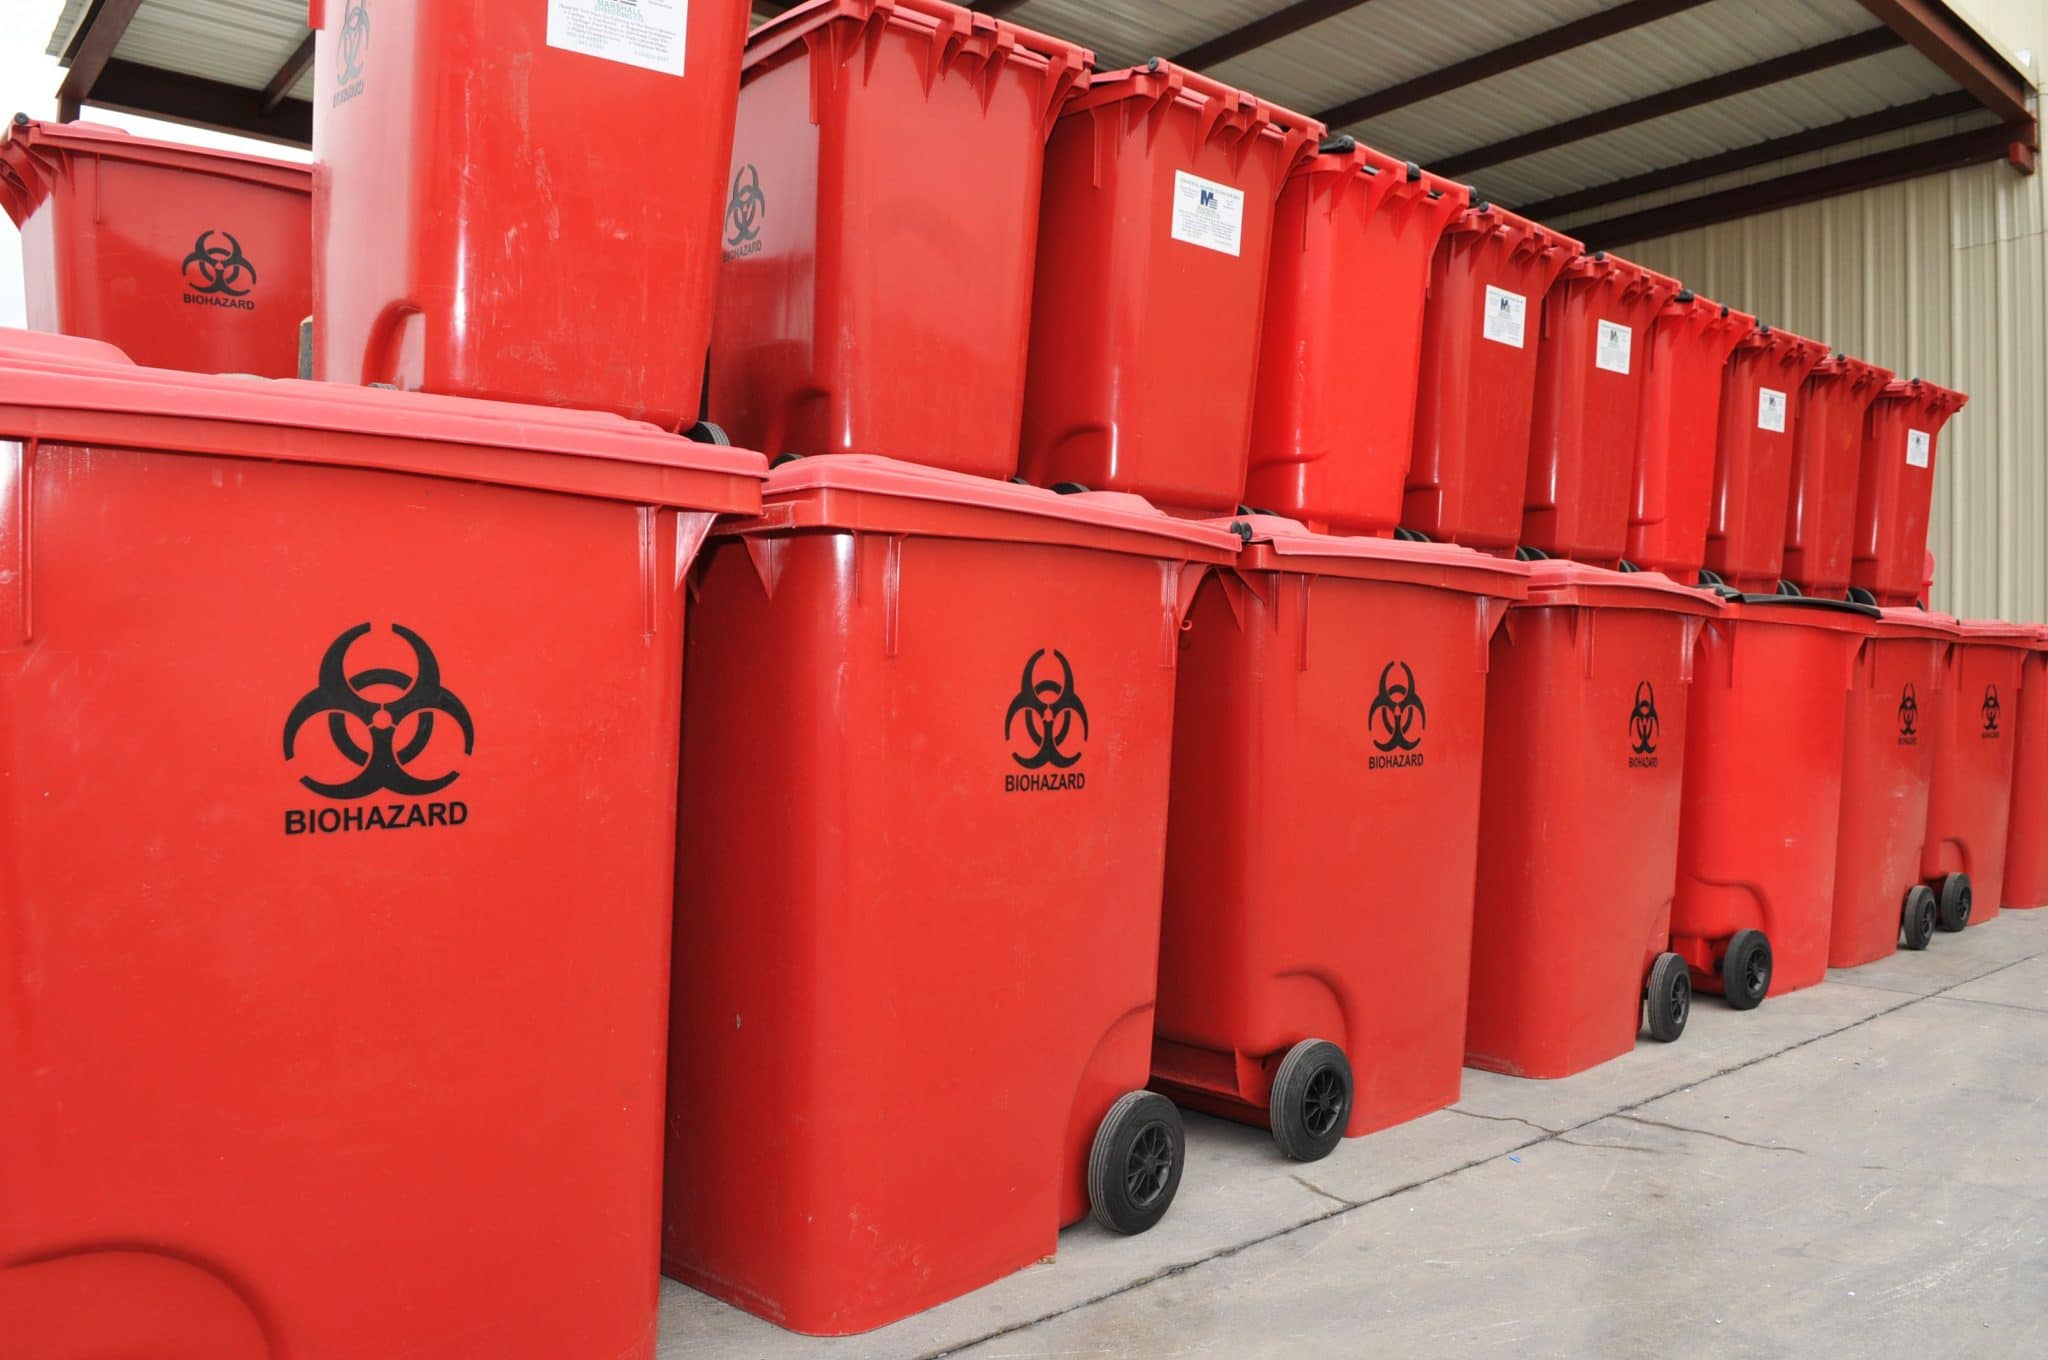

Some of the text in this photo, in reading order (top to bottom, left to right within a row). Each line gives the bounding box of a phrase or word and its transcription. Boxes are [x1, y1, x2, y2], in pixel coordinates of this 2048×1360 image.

[183, 293, 255, 310] BIOHAZARD
[1369, 754, 1424, 769] BIOHAZARD
[1005, 773, 1085, 792] BIOHAZARD
[285, 802, 467, 835] BIOHAZARD
